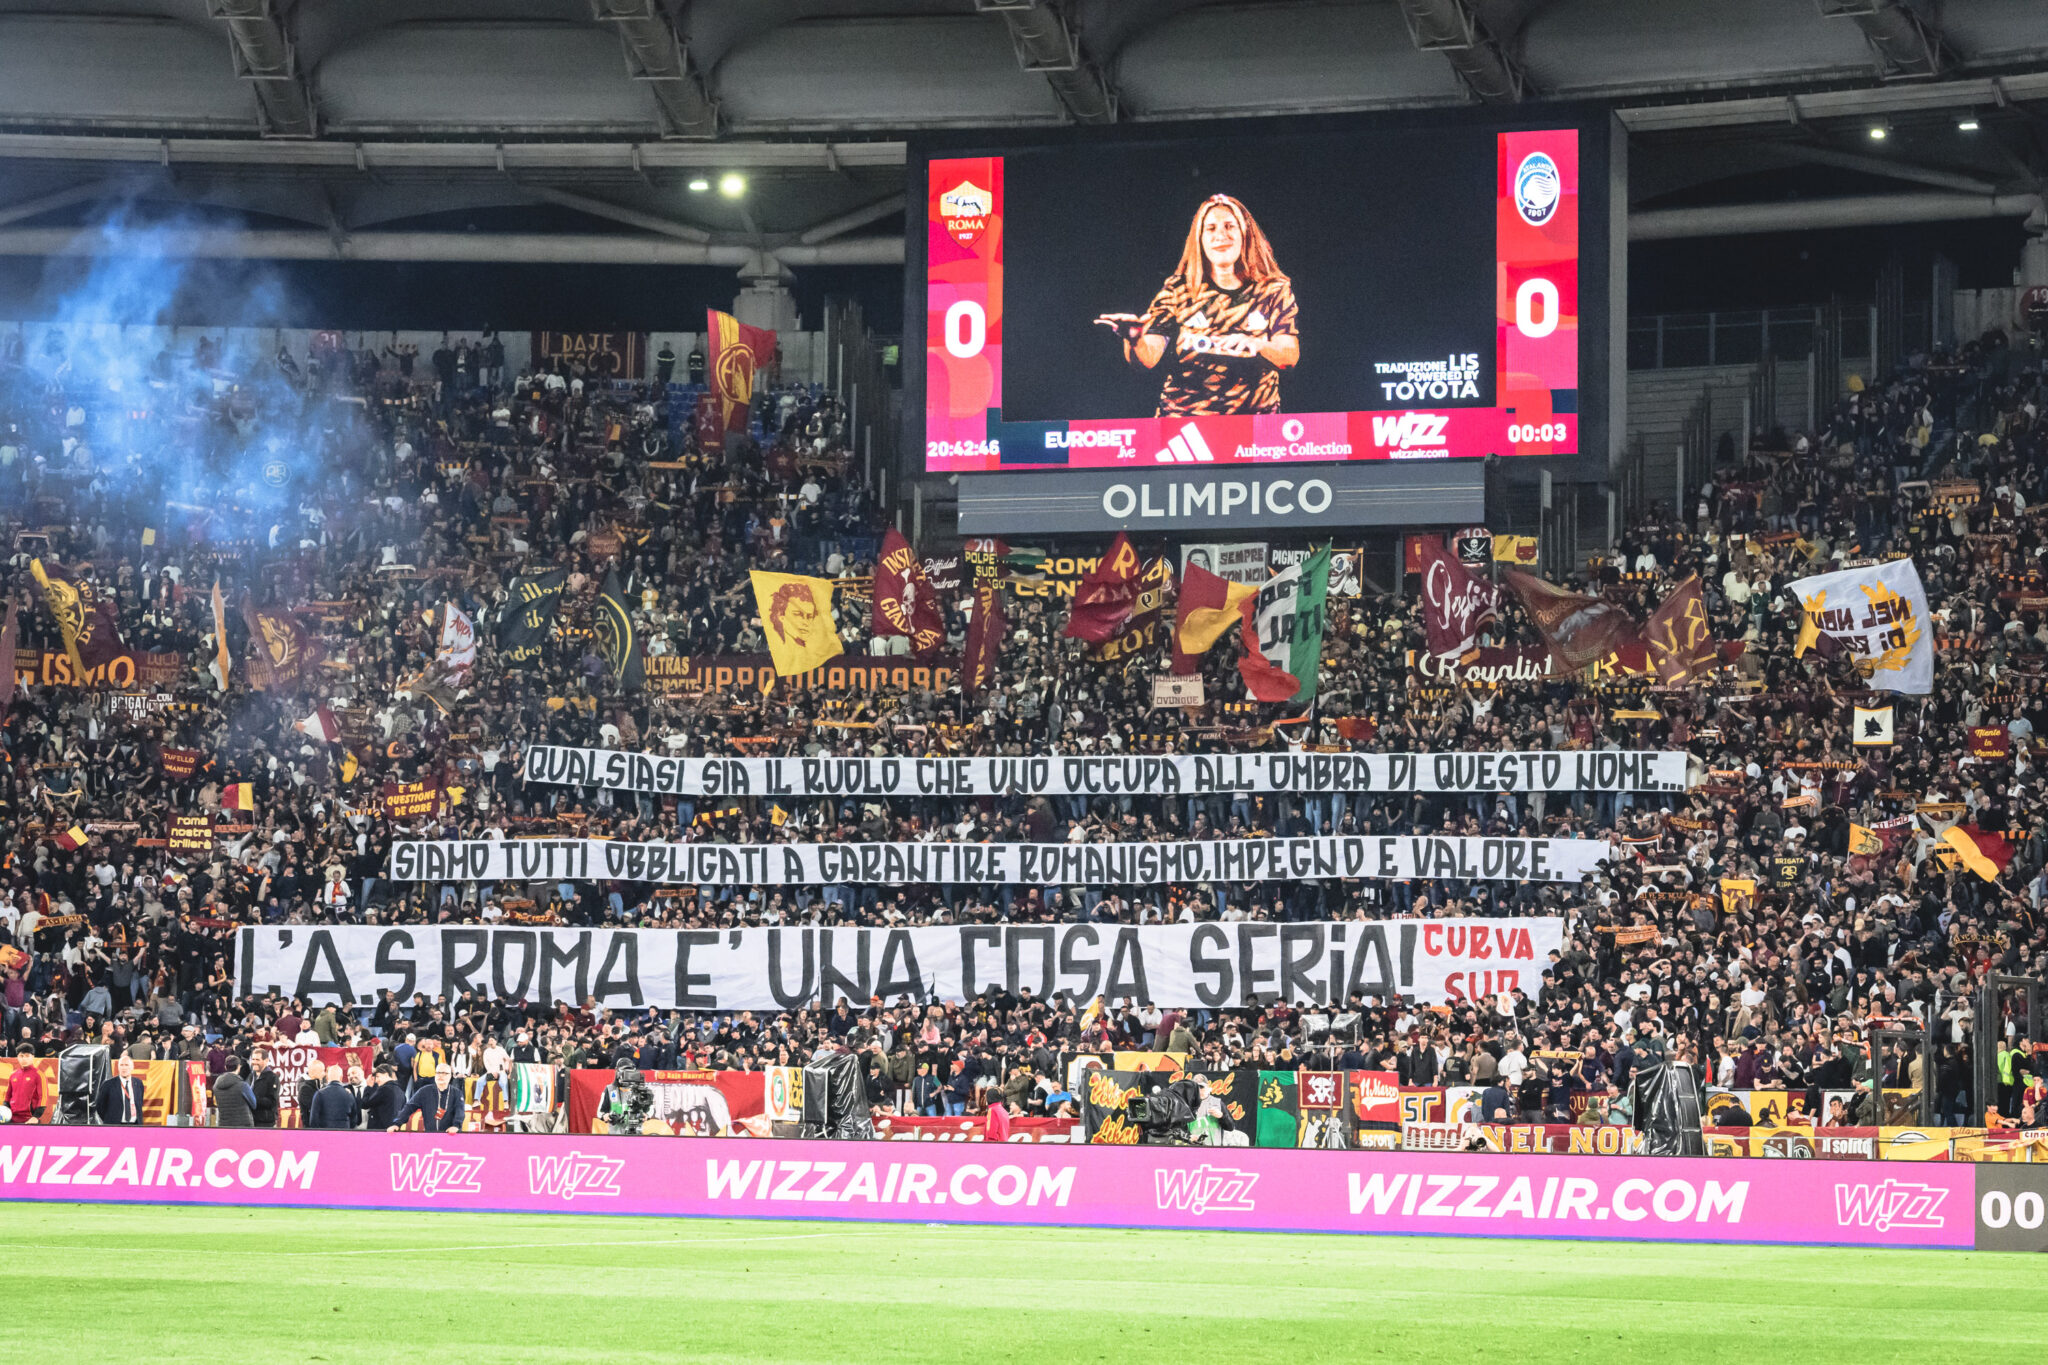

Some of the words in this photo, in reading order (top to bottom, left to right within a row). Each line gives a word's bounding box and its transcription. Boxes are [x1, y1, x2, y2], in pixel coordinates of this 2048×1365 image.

[948, 219, 985, 231] ROMA
[1515, 277, 1560, 338] 0
[944, 300, 987, 358] 0
[562, 332, 613, 353] DAJE
[1374, 361, 1447, 374] TRADUZIONE
[1449, 353, 1480, 372] LIS
[1407, 370, 1460, 383] POWERED
[1463, 370, 1479, 381] BY
[1381, 380, 1480, 401] TOYOTA
[1044, 429, 1137, 449] EUROBET
[1507, 423, 1567, 443] 00:03
[927, 439, 1000, 457] 20:42:46
[1234, 444, 1288, 460] Auberge
[1288, 442, 1353, 457] Collection
[1389, 448, 1450, 460] wizzair.com
[1102, 478, 1334, 519] OLIMPICO
[1220, 547, 1265, 566] SEMPRE
[644, 656, 690, 675] ULTRAS
[1974, 728, 2001, 738] Niente
[527, 746, 685, 793] QUALSIASI
[701, 758, 750, 796] SIA
[765, 757, 792, 795] IL
[802, 758, 900, 795] RUOLO
[916, 759, 974, 794] CHE
[988, 757, 1050, 794] UNO
[1063, 757, 1182, 794] OCCUPA
[1200, 752, 1372, 792] ALL'OMBRA
[1389, 752, 1417, 791] DI
[1434, 753, 1561, 791] QUESTO
[387, 789, 436, 805] QUESTIONE
[394, 806, 407, 817] DE
[408, 802, 432, 814] CORE
[396, 843, 490, 880] SIAMO
[503, 841, 588, 879] TUTTI
[605, 842, 769, 885] OBBLIGATI
[783, 844, 805, 884] A
[817, 844, 1007, 884] GARANTIRE
[1377, 838, 1400, 877] E
[1411, 838, 1564, 881] VALORE.
[1774, 857, 1805, 865] BRIGATA
[1423, 923, 1534, 961] CURVA
[440, 929, 643, 1008] ROMA
[766, 927, 925, 1007] UNA
[960, 924, 1150, 1005] COSA
[705, 1159, 1077, 1208] WIZZAIR.COM
[1347, 1171, 1750, 1224] WIZZAIR.COM
